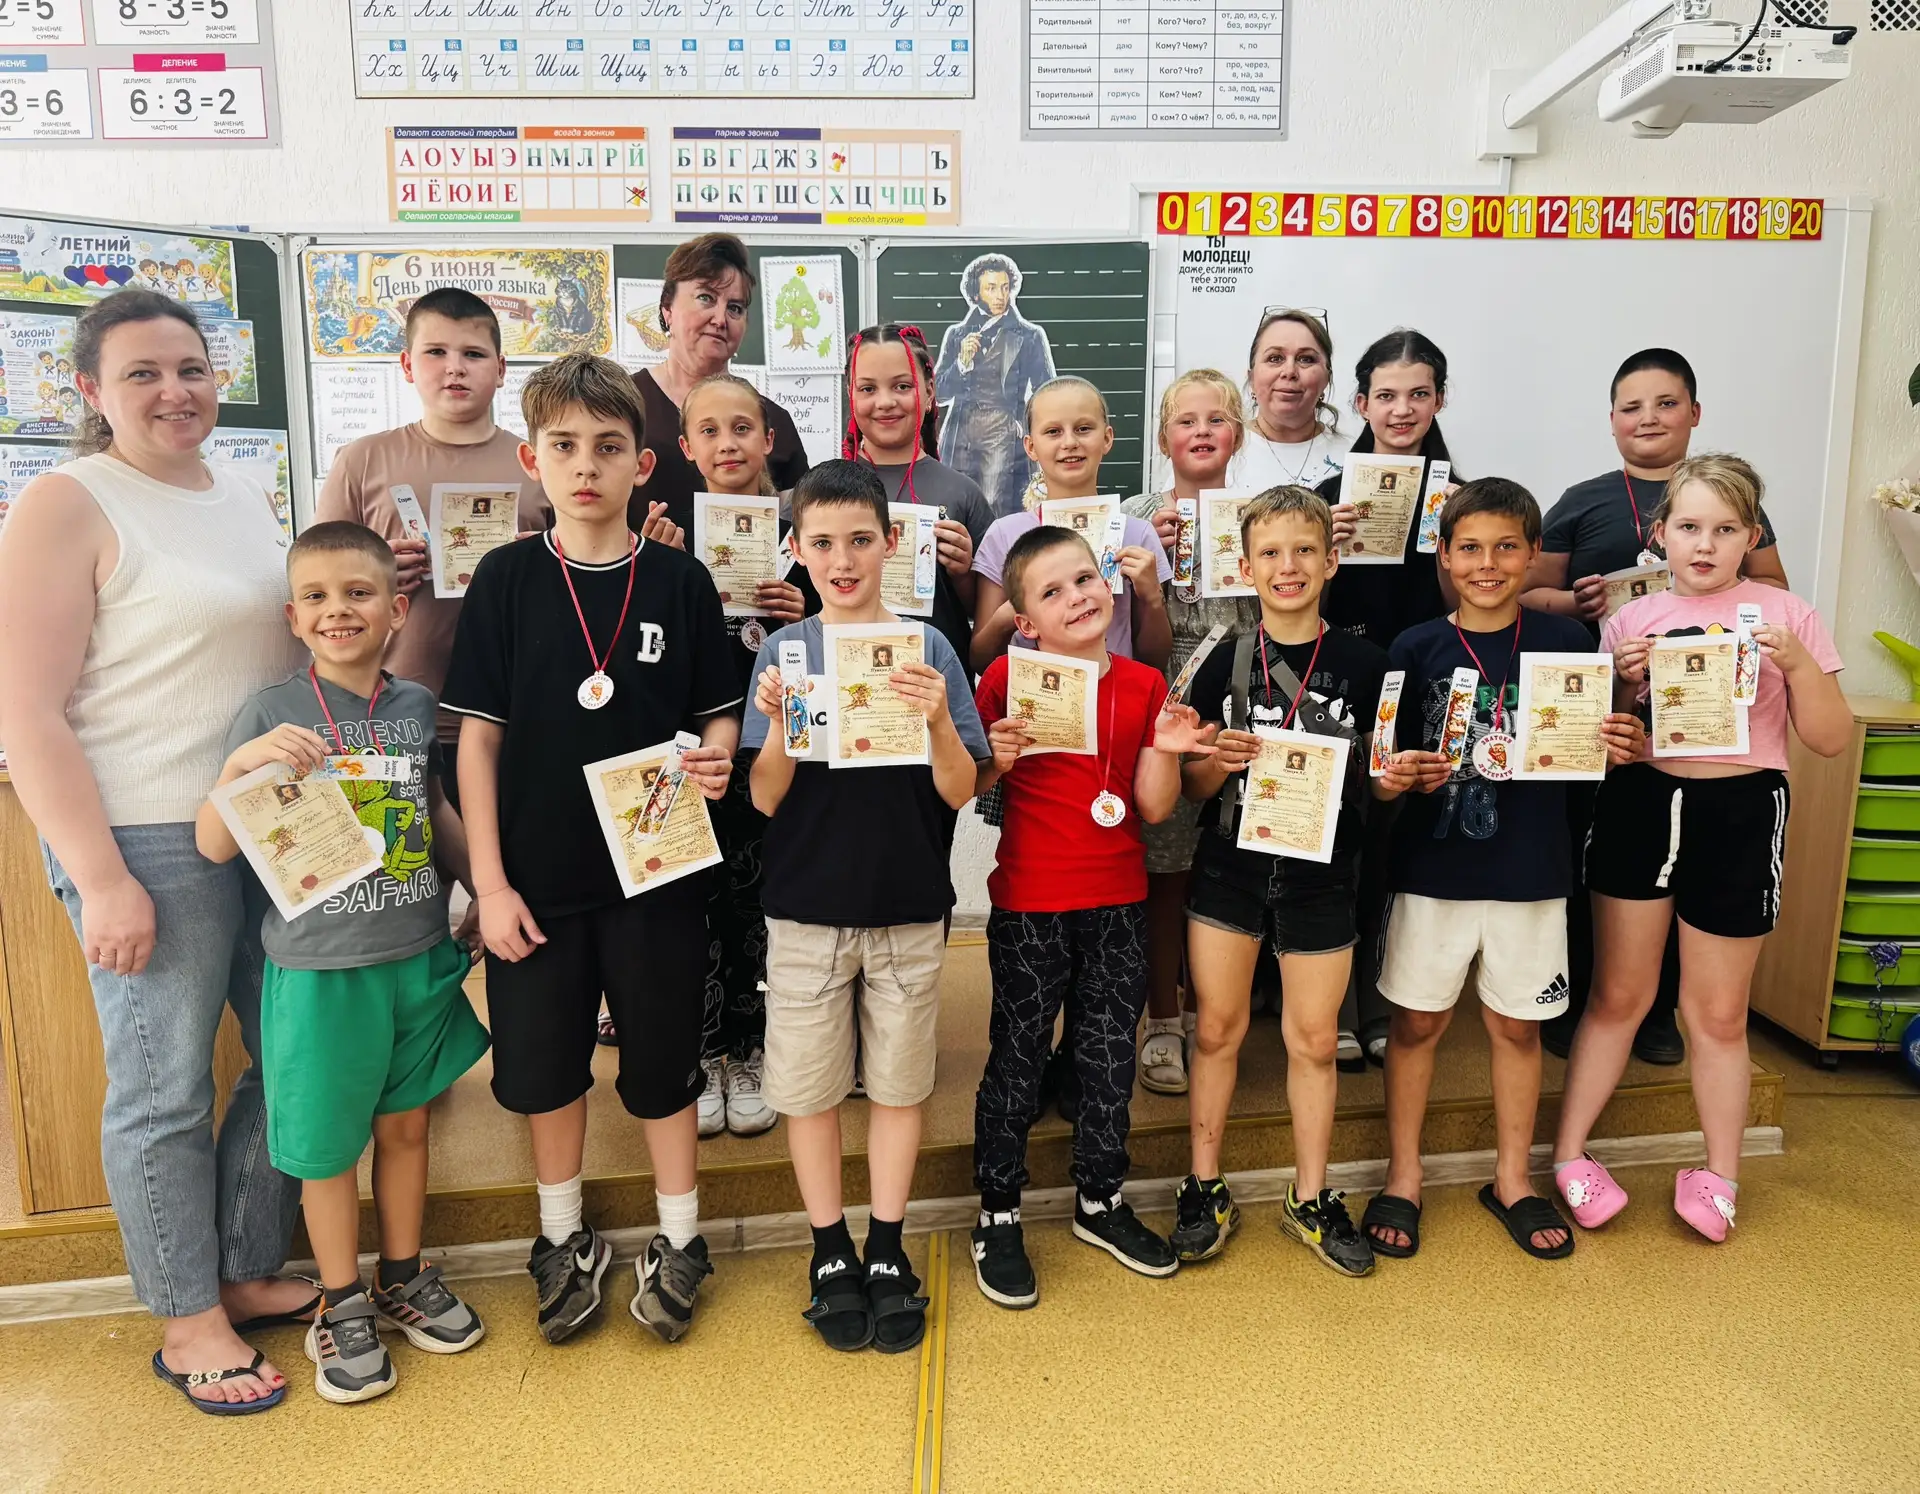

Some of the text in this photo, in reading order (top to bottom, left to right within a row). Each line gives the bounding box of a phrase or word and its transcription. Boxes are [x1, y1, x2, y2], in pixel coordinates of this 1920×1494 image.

[1038, 17, 1092, 27] Родительный
[1157, 17, 1206, 26] Кого? Чего?
[1227, 20, 1272, 30] без, вокруг
[1043, 42, 1087, 51] Дательный
[1155, 42, 1208, 50] Кому? Чему?
[161, 59, 198, 67] ДЕЛЕНИЕ
[1226, 62, 1243, 70] про,
[1037, 65, 1091, 74] Винительный
[1114, 67, 1134, 75] вижу
[1159, 67, 1203, 75] Кого? Что?
[1181, 90, 1202, 98] Чем?
[1234, 95, 1260, 103] между
[1038, 113, 1090, 122] Предложный
[1111, 114, 1137, 122] думаю
[1160, 113, 1179, 121] ком?
[1181, 113, 1188, 121] О
[397, 128, 515, 138] делают согласный твердым
[554, 129, 582, 137] всегда
[715, 129, 779, 138] парные звонкие
[404, 212, 513, 221] делают согласный мягким
[719, 214, 778, 222] парные глухие
[848, 216, 904, 224] всегда глухие
[1162, 195, 1821, 236] 0 1 2 3 4 5 6 7 8 9 10 11 12 13 14 15 16 17 18 19 20
[59, 235, 131, 251] ЛЕТНИЙ
[1206, 236, 1225, 248] ТЫ
[72, 252, 136, 266] ЛАГЕРЬ
[1183, 250, 1250, 264] МОЛОДЕЦ!
[405, 256, 495, 278] 6 июня
[1179, 266, 1203, 274] даже
[1190, 272, 1210, 283] тебе
[373, 275, 420, 300] День
[498, 280, 546, 296] языка
[488, 296, 519, 310] России
[10, 329, 55, 339] ЗАКОНЫ
[16, 338, 53, 347] ОРЛЯТ
[774, 392, 829, 403] Лукоморья
[794, 408, 811, 418] дуб
[214, 437, 270, 447] РАСПОРЯДОК
[232, 448, 258, 459] ДНЯ
[10, 460, 53, 468] ПРАВИЛА
[637, 622, 663, 663] D
[314, 718, 423, 751] FRIEND
[323, 867, 438, 914] SAFARI
[817, 1259, 846, 1280] FILA
[870, 1263, 899, 1277] FILA
